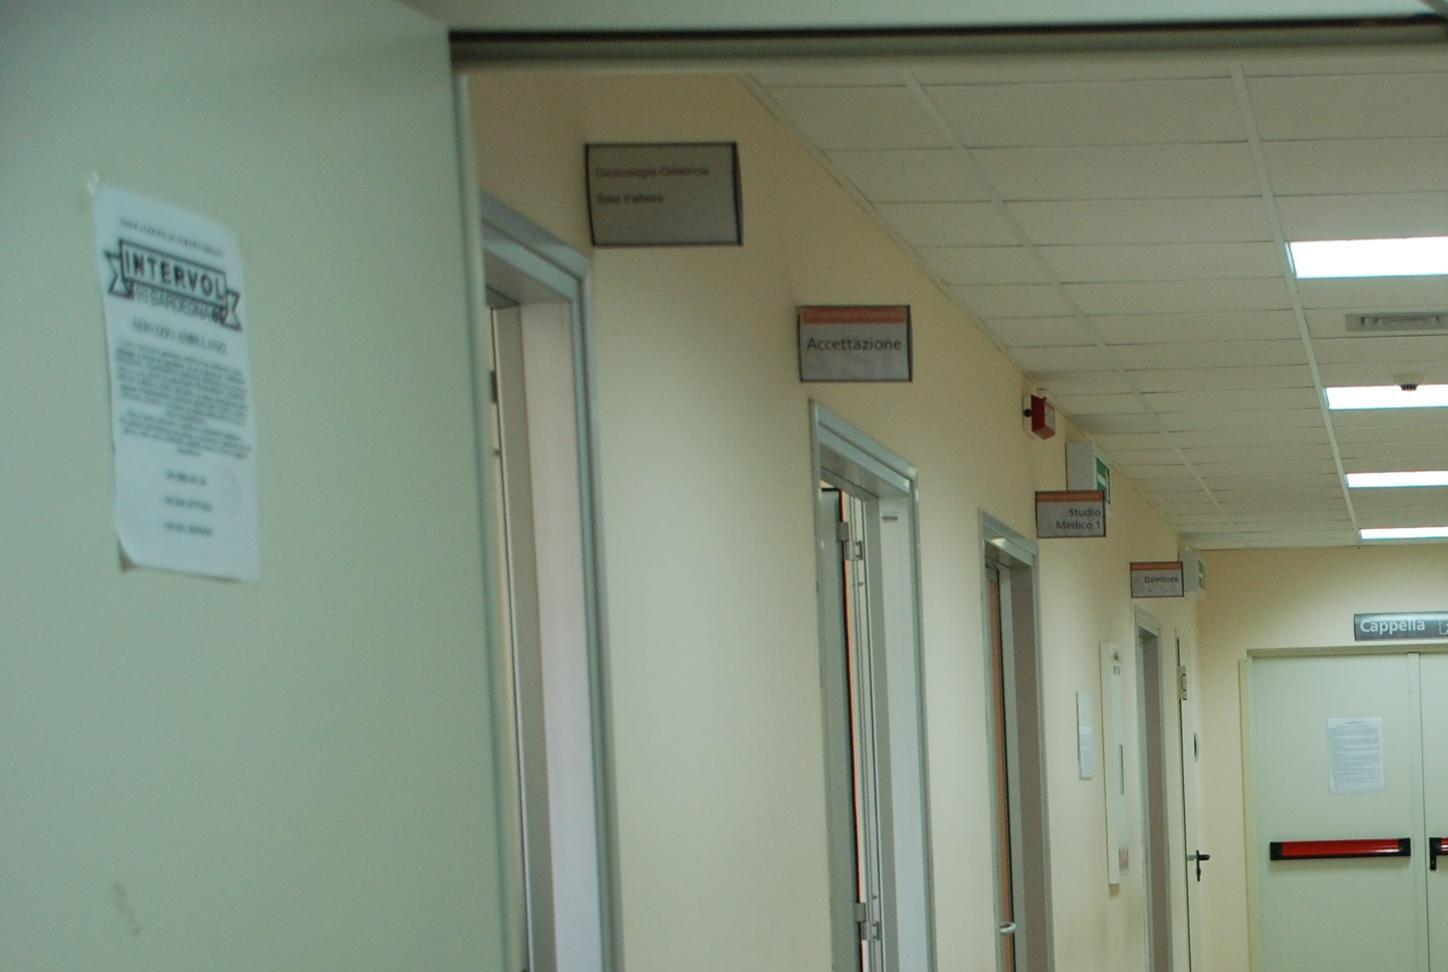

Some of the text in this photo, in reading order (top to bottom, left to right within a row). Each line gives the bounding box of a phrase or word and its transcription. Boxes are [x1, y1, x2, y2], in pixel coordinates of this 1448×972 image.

[124, 249, 225, 302] INTERVOL
[806, 337, 902, 351] Accettazione
[1068, 507, 1101, 517] Studio
[1056, 520, 1093, 530] Medico
[1360, 618, 1425, 635] Cappella
